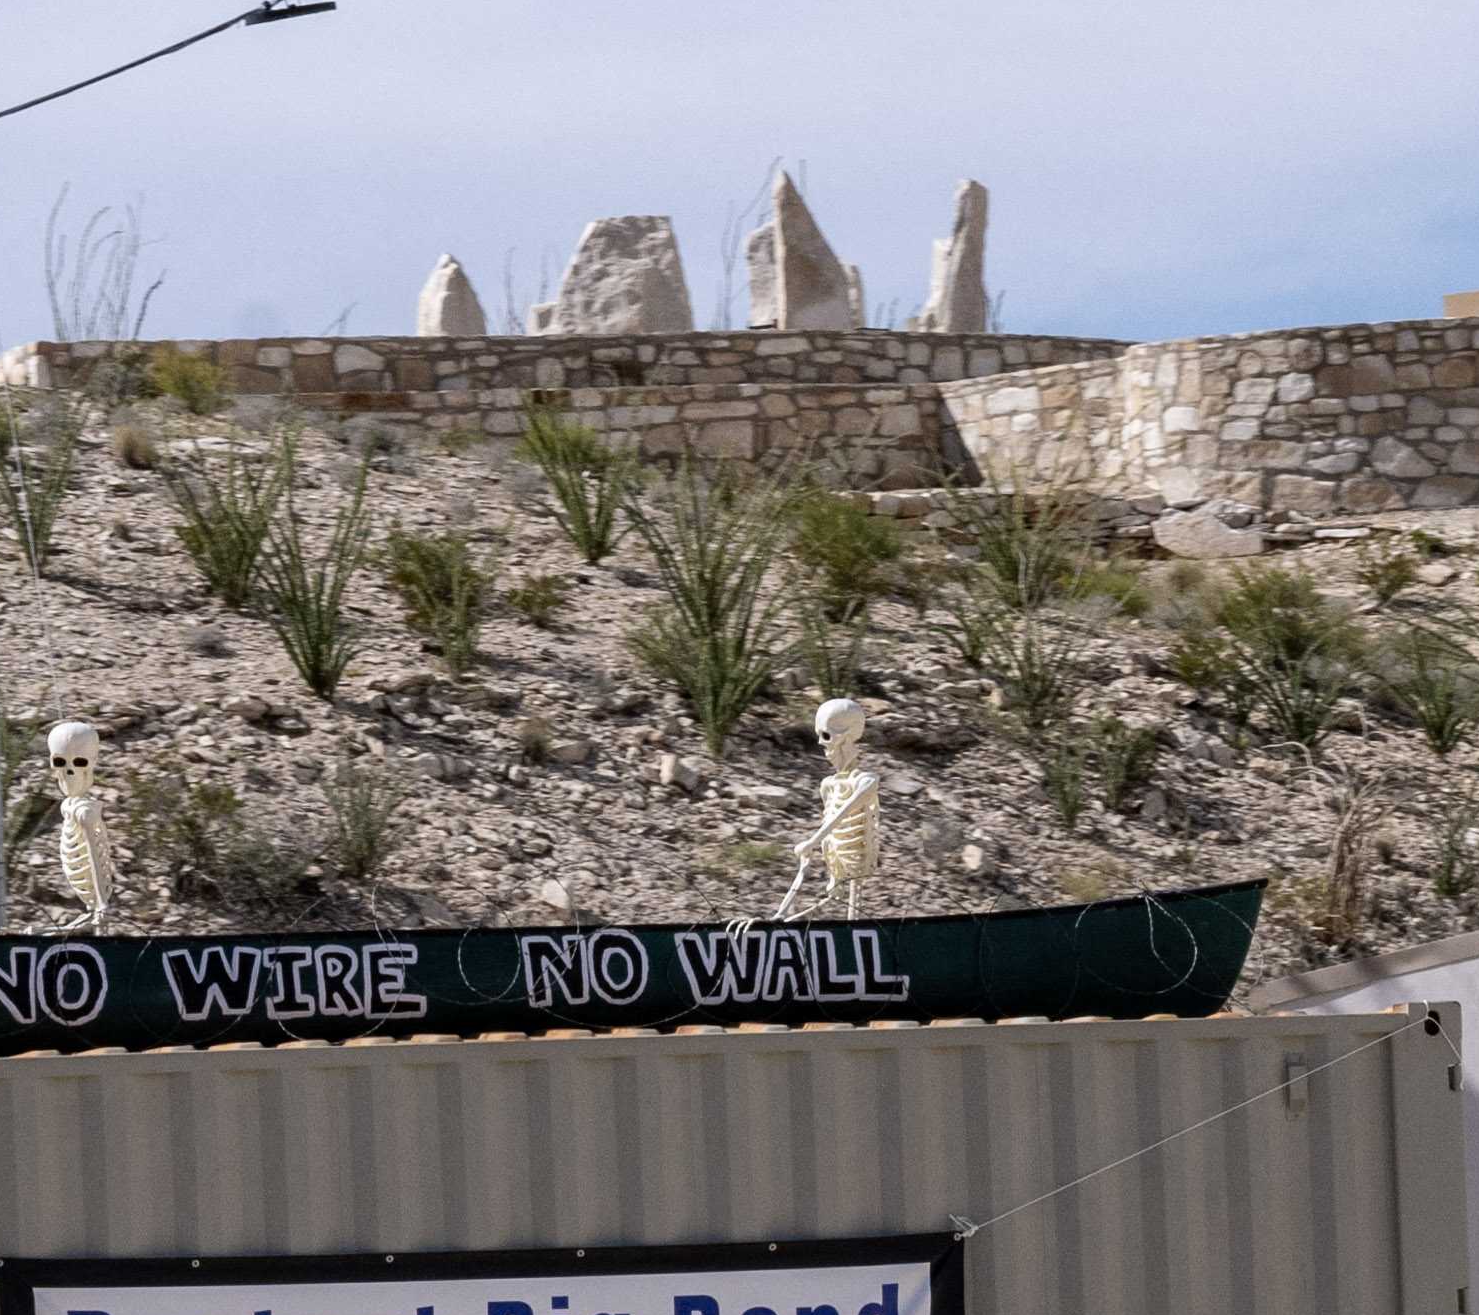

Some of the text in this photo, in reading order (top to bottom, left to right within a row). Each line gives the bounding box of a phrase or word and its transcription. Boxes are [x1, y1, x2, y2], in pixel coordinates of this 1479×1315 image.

[162, 944, 427, 1021] WIRE
[521, 928, 649, 1007] NO
[674, 929, 910, 1005] WALL
